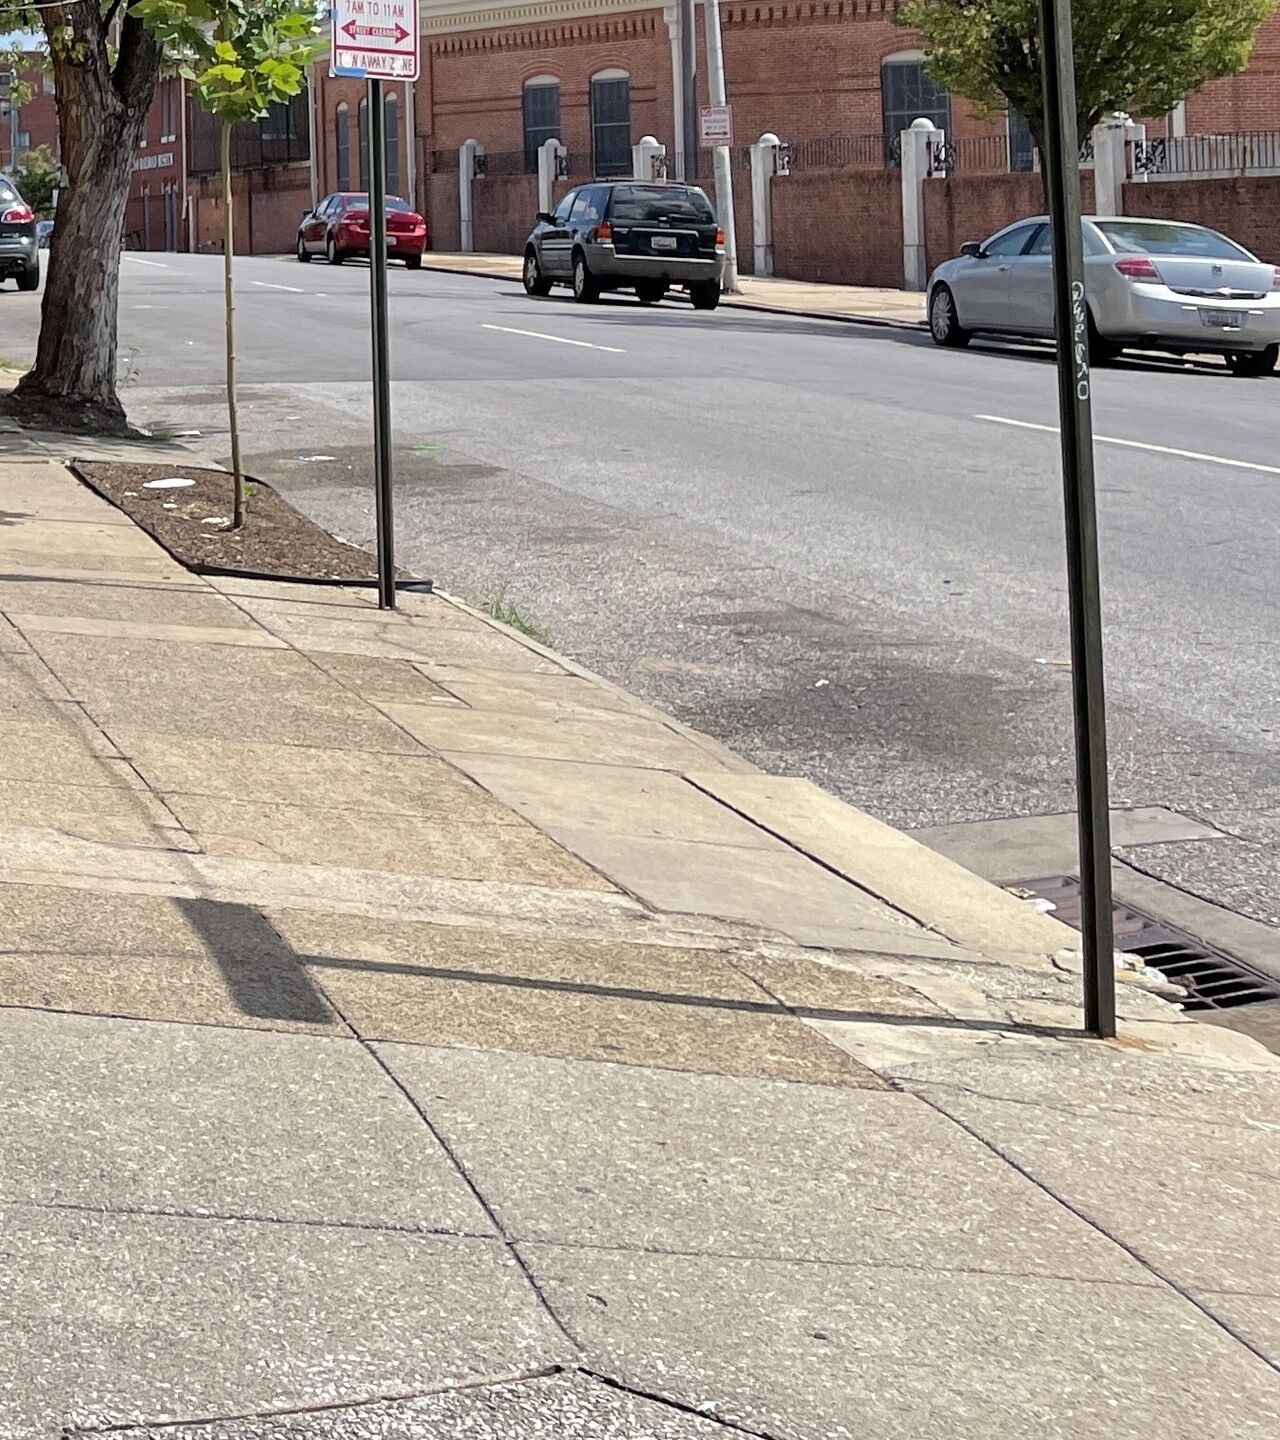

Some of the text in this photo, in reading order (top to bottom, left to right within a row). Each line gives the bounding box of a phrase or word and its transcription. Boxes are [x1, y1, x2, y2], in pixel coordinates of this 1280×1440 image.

[367, 1, 380, 16] TO
[361, 54, 387, 69] AWAY
[389, 56, 414, 72] ZNE
